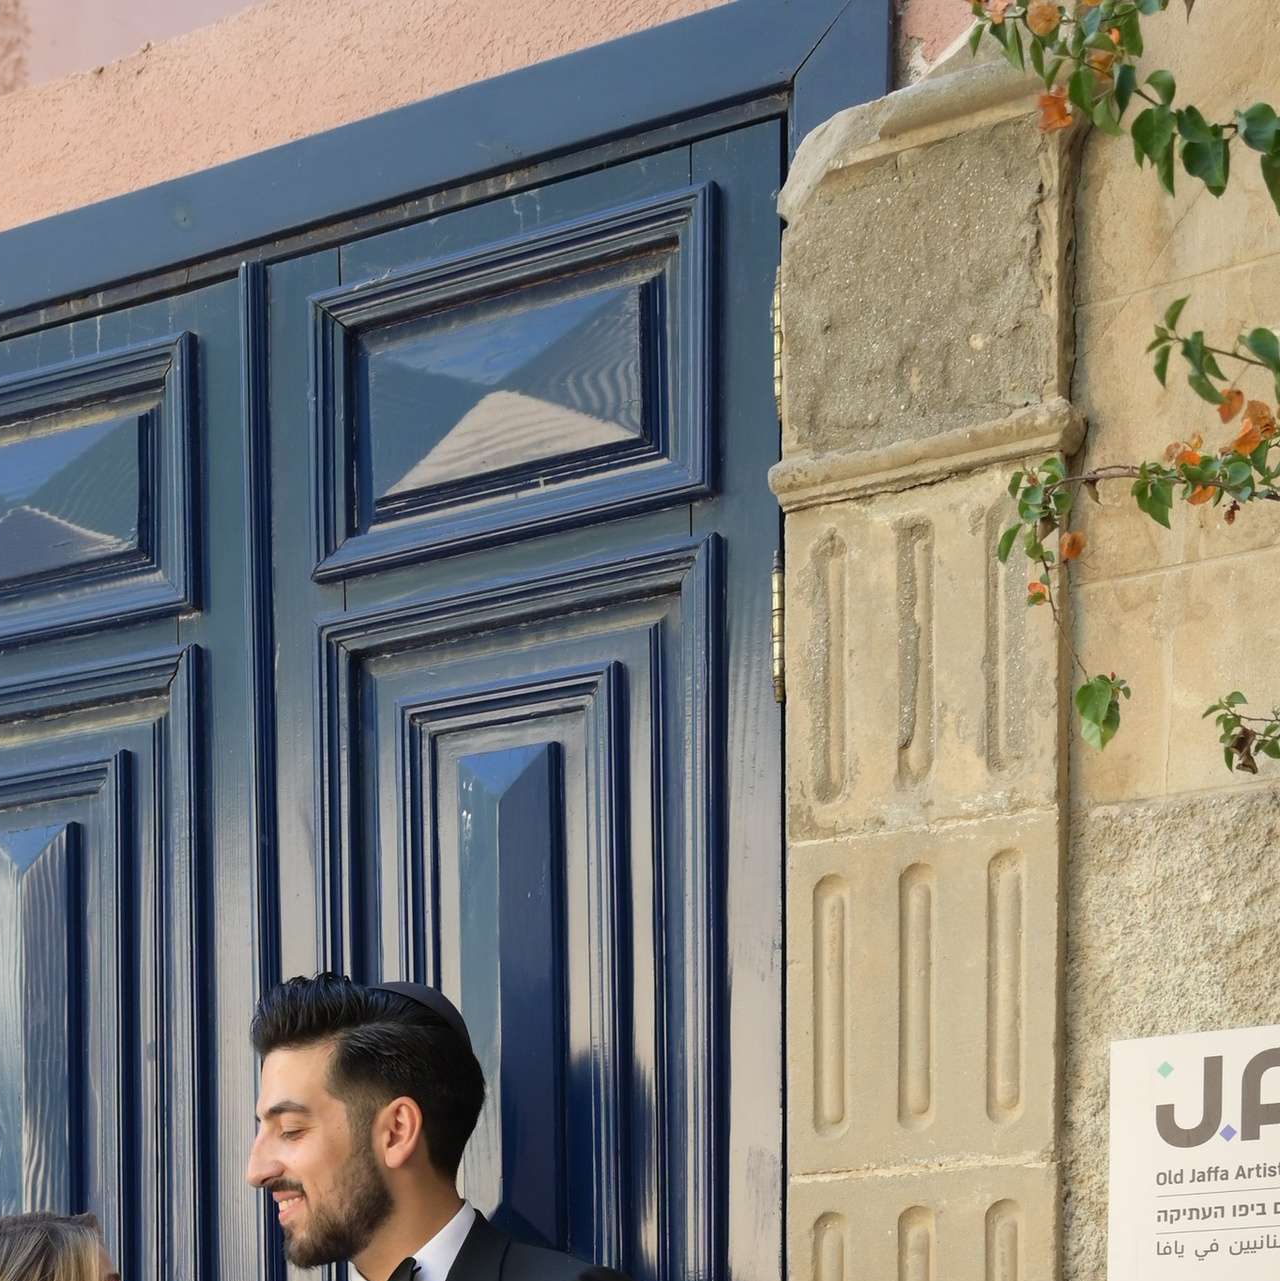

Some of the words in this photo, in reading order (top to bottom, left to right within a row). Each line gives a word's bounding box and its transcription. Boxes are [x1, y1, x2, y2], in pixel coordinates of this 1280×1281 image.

[1156, 1168, 1184, 1186] Old
[1189, 1166, 1229, 1183] Jaffa
[1157, 1206, 1225, 1224] העתיקה
[1232, 1203, 1266, 1217] ביפו
[1157, 1240, 1185, 1258] يافا
[1194, 1239, 1219, 1261] في
